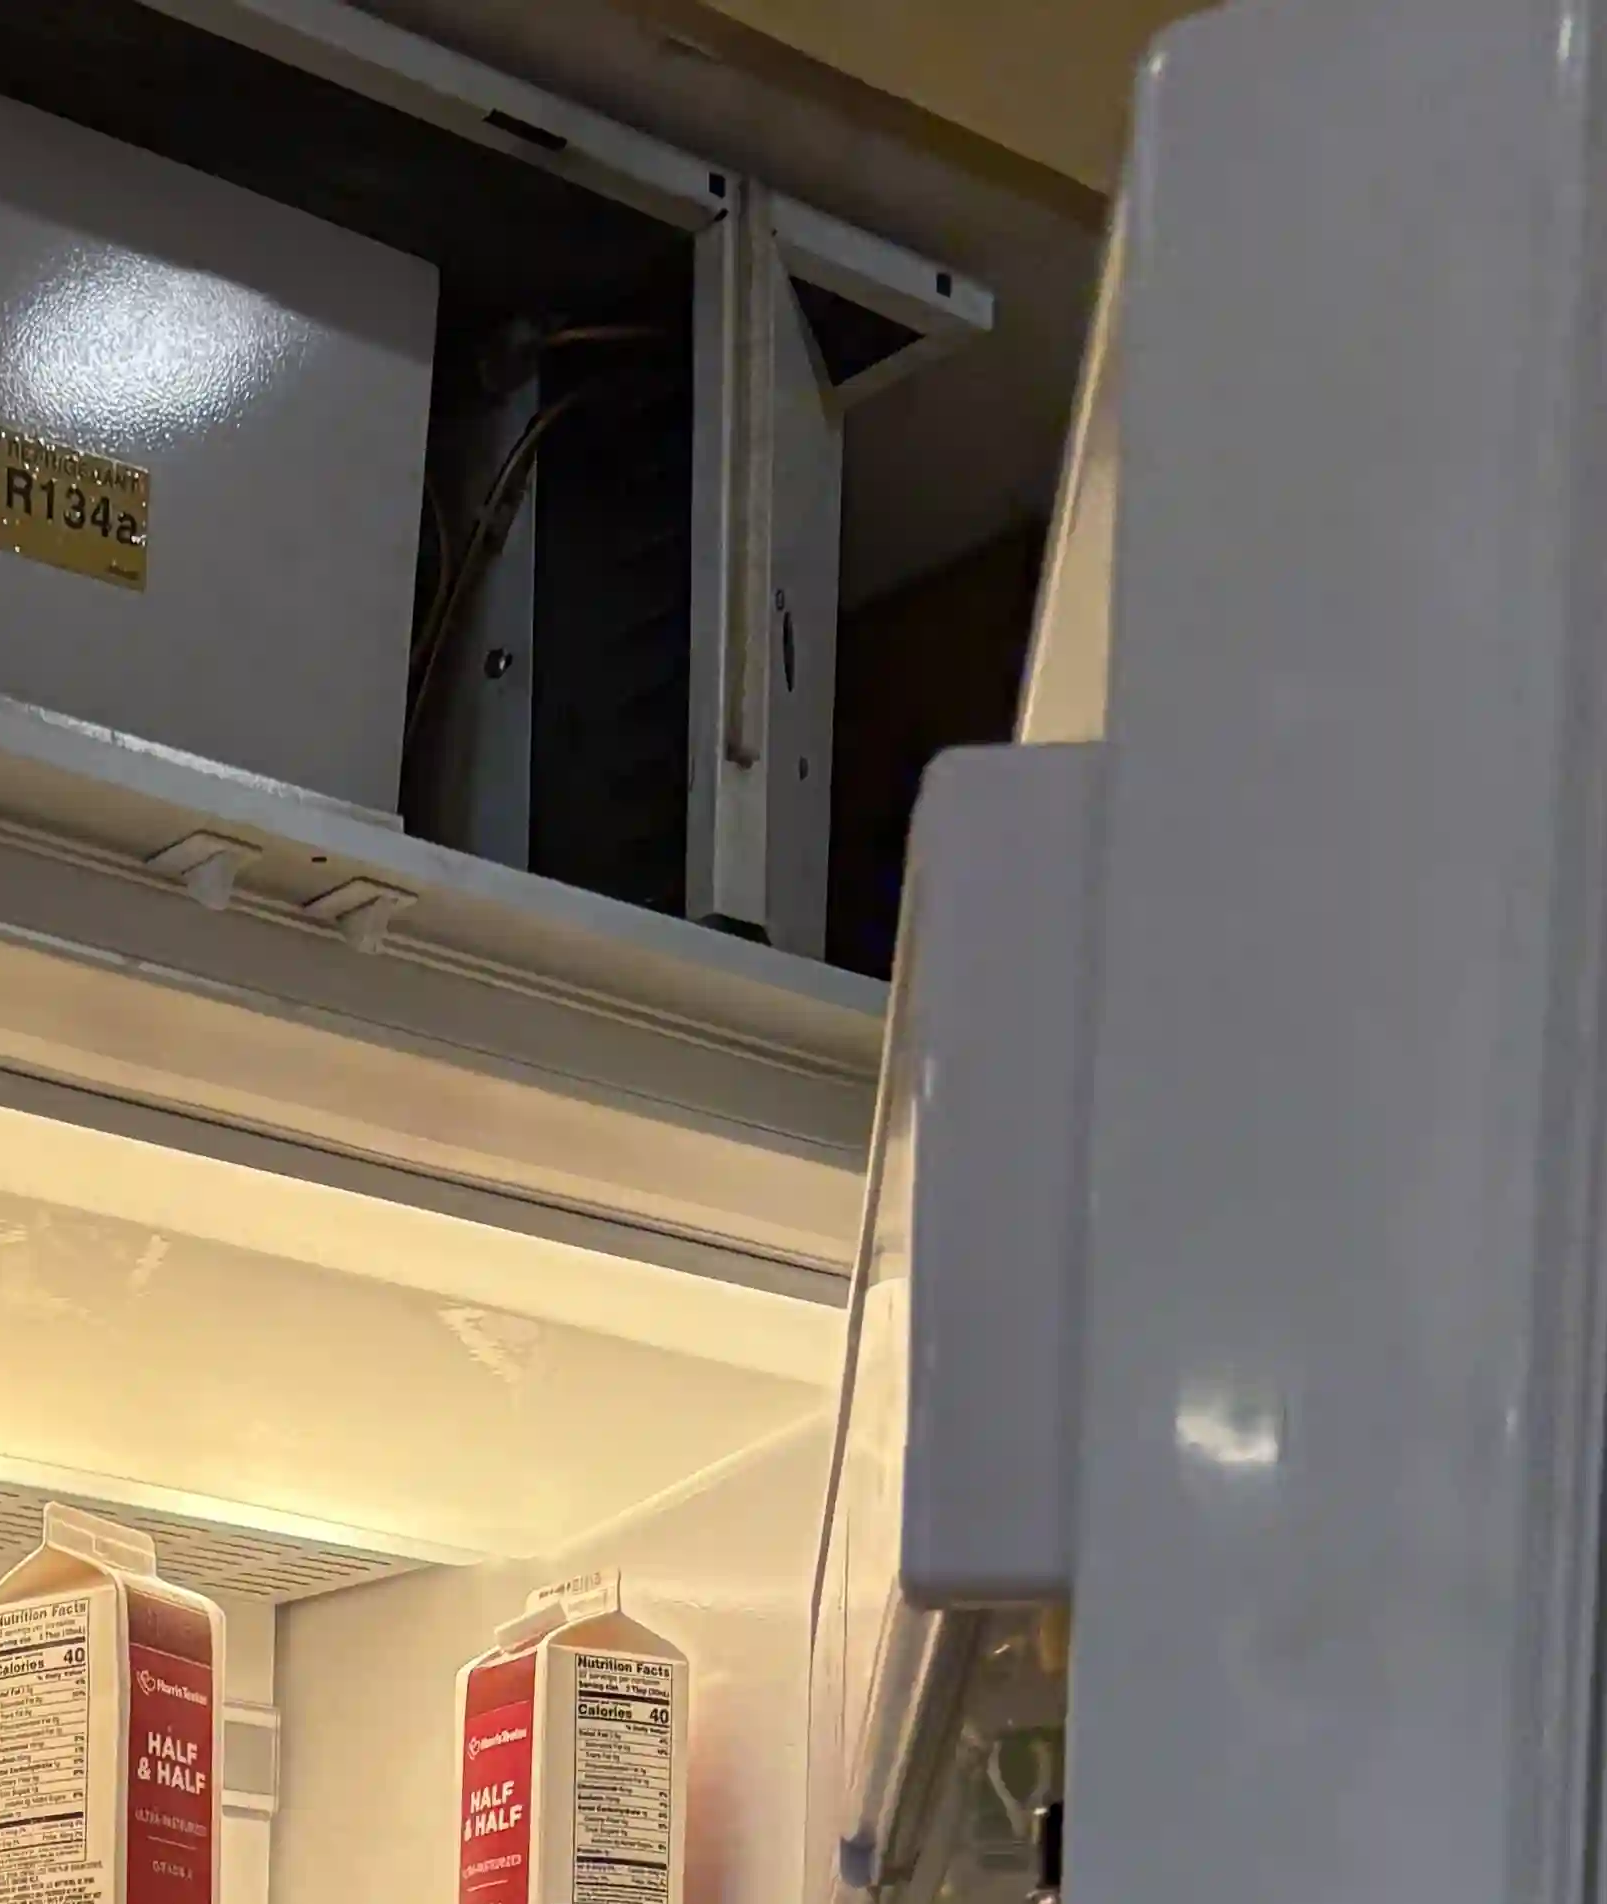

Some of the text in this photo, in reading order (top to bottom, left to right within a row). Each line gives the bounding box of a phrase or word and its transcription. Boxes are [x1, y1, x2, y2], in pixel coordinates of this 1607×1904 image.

[5, 467, 140, 546] R134a
[51, 1600, 86, 1617] Facts
[63, 1647, 86, 1664] 40
[577, 1655, 670, 1677] Nutrition Facts
[578, 1704, 669, 1724] Calories 40
[148, 1731, 197, 1766] HALF
[138, 1757, 207, 1795] & HALF
[470, 1781, 515, 1814] HALF
[475, 1804, 523, 1838] HALF
